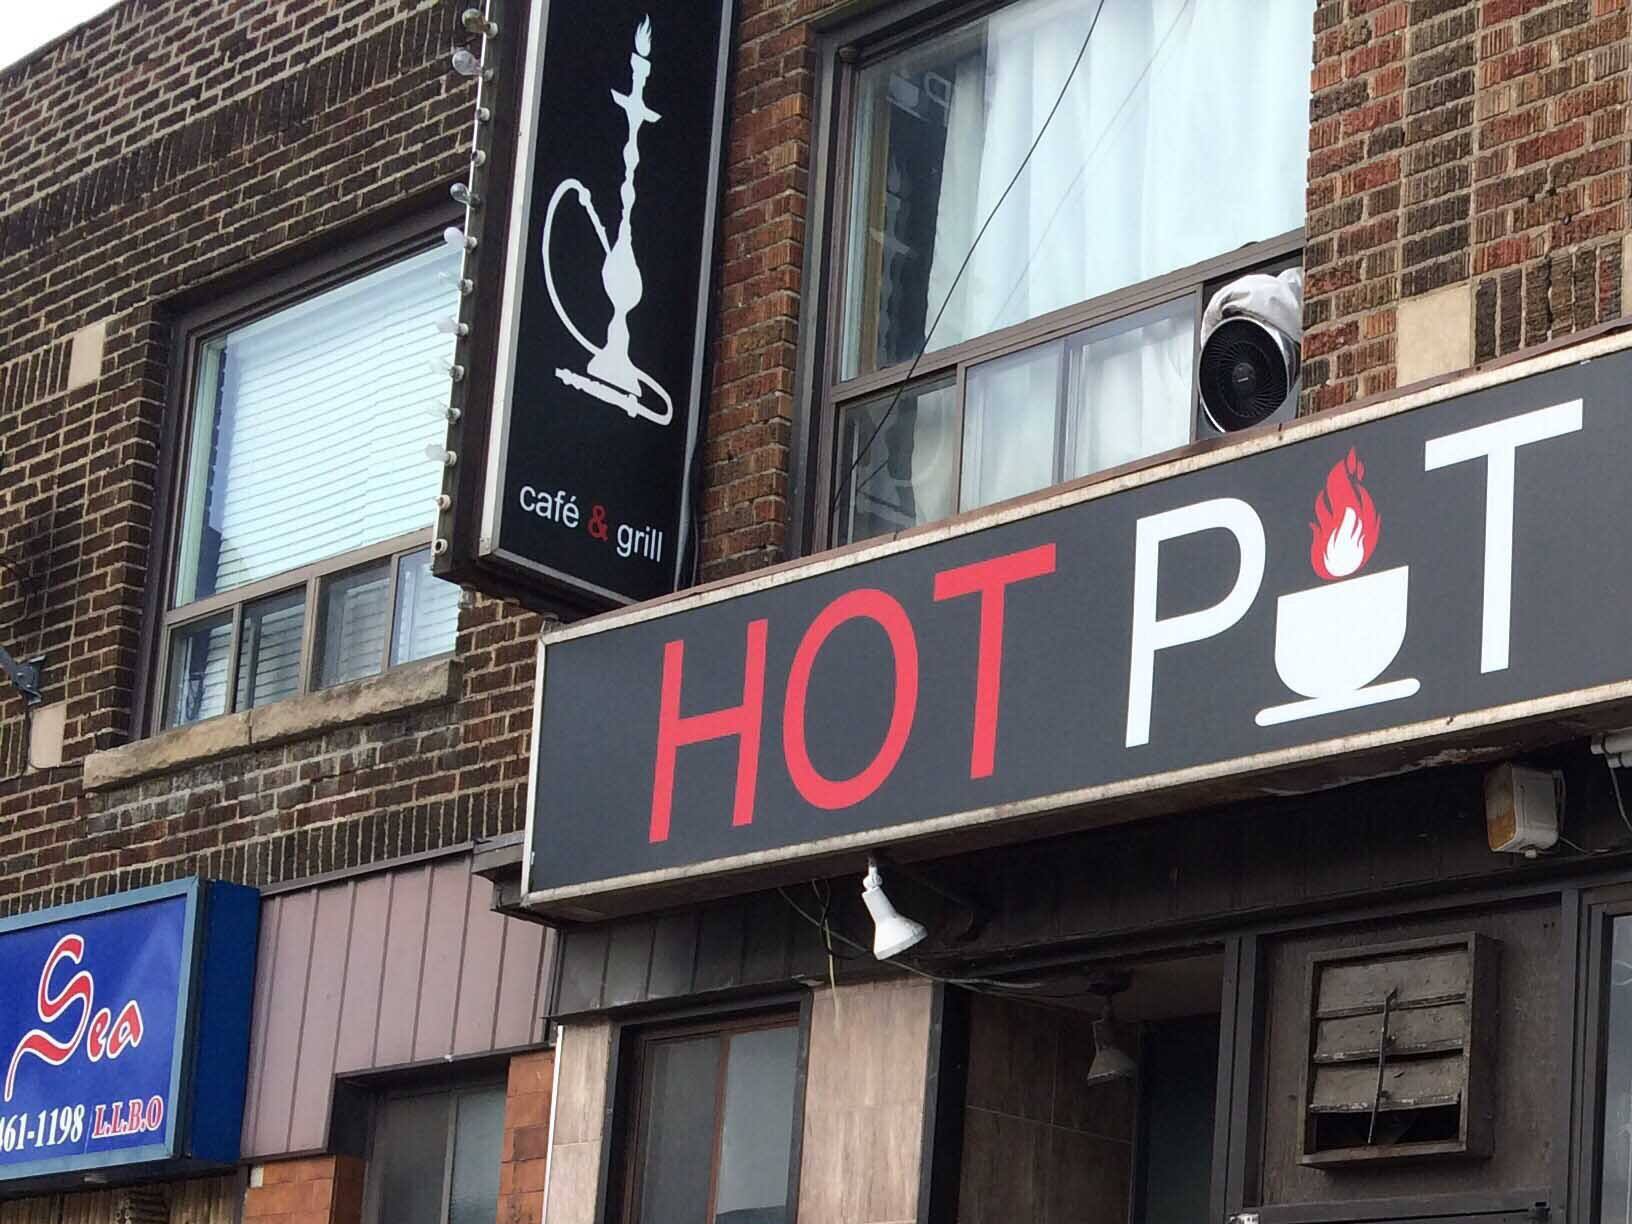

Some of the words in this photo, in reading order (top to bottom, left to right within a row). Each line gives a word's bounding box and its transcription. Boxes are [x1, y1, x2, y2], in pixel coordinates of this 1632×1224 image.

[519, 485, 580, 528] café
[587, 504, 609, 542] &
[616, 523, 663, 562] grill
[648, 542, 1057, 844] HOT
[4, 933, 143, 1101] Sea
